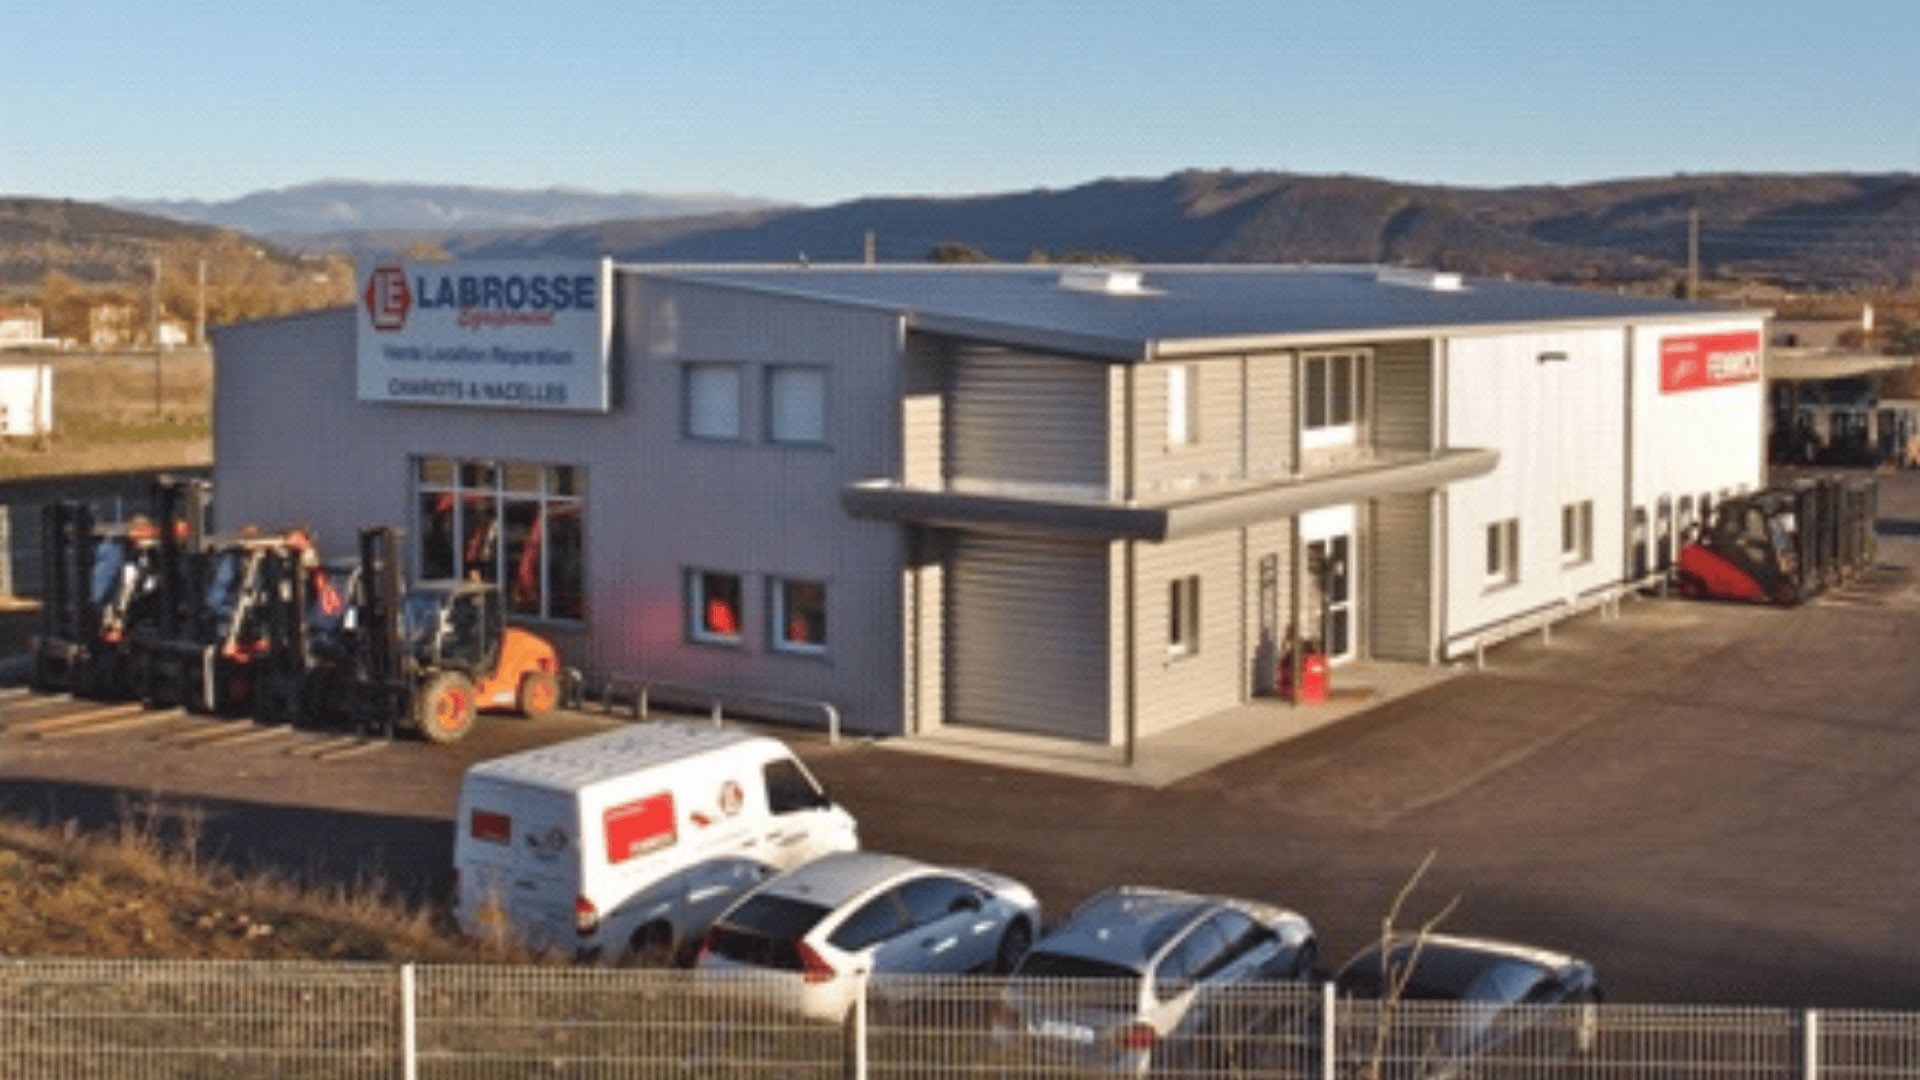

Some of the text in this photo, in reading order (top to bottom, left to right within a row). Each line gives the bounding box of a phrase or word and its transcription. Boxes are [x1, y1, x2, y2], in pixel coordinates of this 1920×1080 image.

[417, 276, 595, 309] LABROSSE
[426, 346, 485, 363] Location
[387, 379, 463, 399] CHARIOTS
[482, 383, 568, 403] NACELLES
